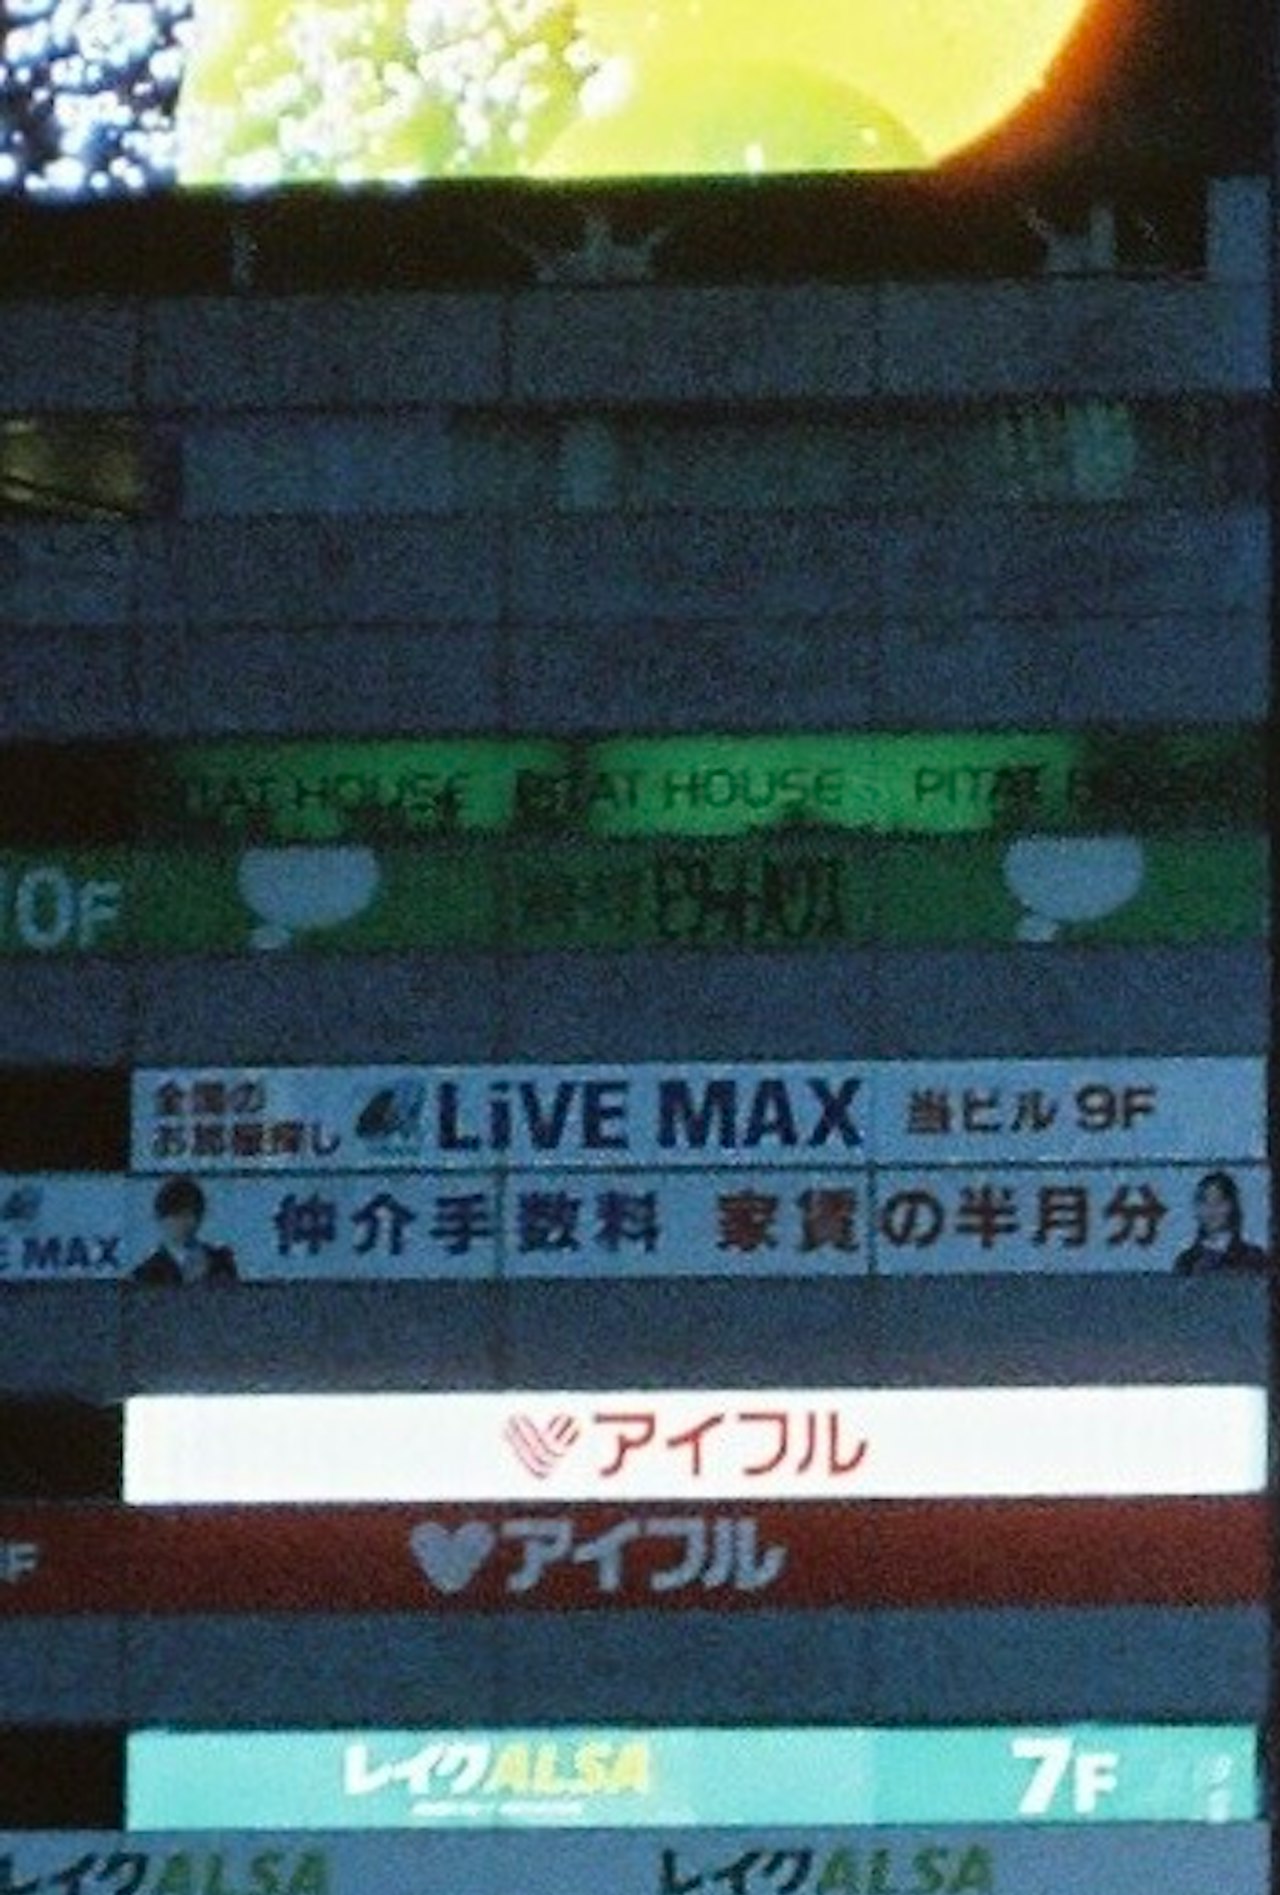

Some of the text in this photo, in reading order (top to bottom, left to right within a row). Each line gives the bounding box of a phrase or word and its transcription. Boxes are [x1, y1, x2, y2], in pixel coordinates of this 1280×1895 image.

[660, 767, 846, 809] HOUSE
[656, 1079, 864, 1149] MAX
[906, 1083, 1158, 1136] 当ビル 9F
[273, 1190, 662, 1257] 仲介手数料
[593, 1411, 869, 1477] アイフル
[500, 1517, 788, 1592] アイフル
[1011, 1736, 1121, 1816] 7F
